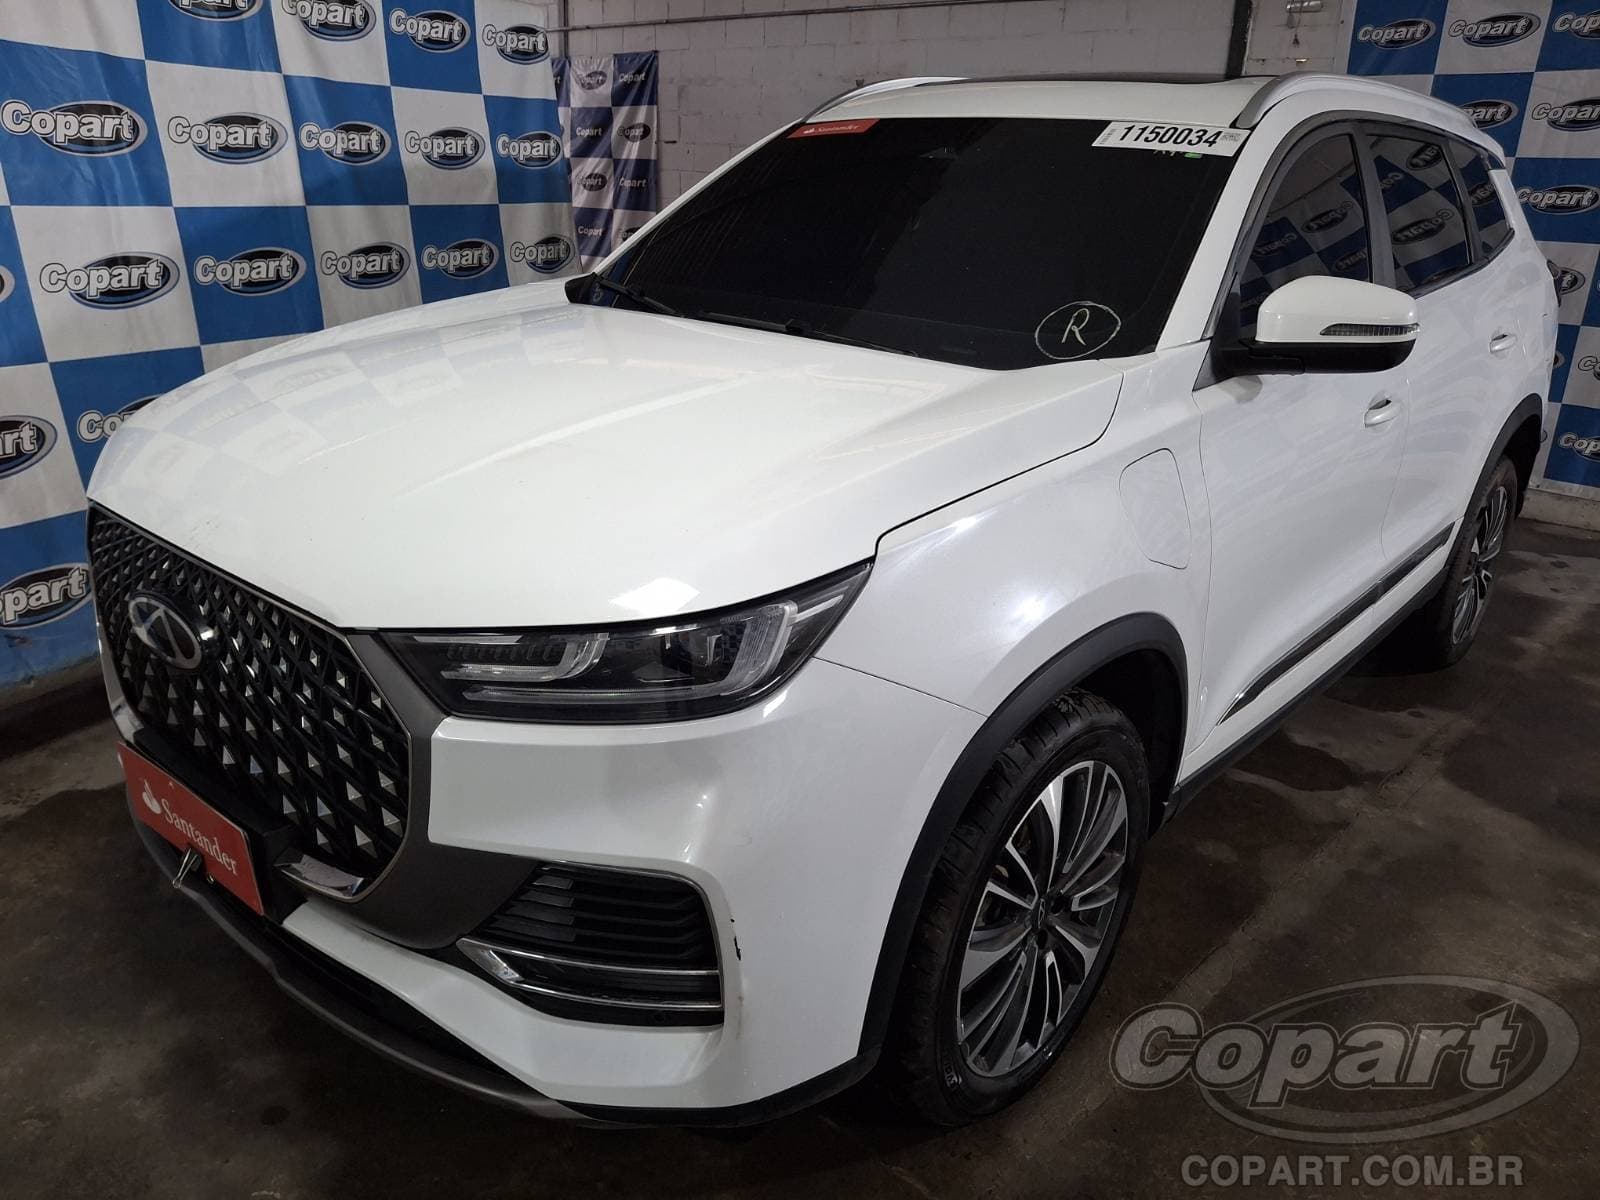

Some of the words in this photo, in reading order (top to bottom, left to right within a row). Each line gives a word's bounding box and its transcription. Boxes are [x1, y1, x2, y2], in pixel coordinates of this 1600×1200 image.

[281, 0, 366, 28] Copart
[389, 9, 464, 44] Copart
[1450, 14, 1531, 38] Copart
[1554, 13, 1600, 34] Cop
[482, 24, 547, 53] Copart
[1358, 20, 1427, 45] Copart
[1, 100, 134, 144] Copart
[1465, 103, 1506, 122] art
[1532, 102, 1600, 125] Copar
[168, 116, 271, 151] Copart
[299, 122, 381, 154] Copart
[405, 130, 475, 158] Copart
[497, 134, 559, 159] Copart
[1119, 125, 1223, 147] 1150034
[1516, 187, 1596, 209] Copart
[321, 247, 400, 280] Copart
[422, 244, 491, 271] Copart
[510, 239, 568, 265] Copart
[40, 258, 163, 299] Copart
[195, 247, 293, 287] Copart
[1061, 308, 1090, 346] R
[1559, 432, 1600, 455] Cop
[0, 567, 86, 624] part
[161, 798, 238, 877] Santander
